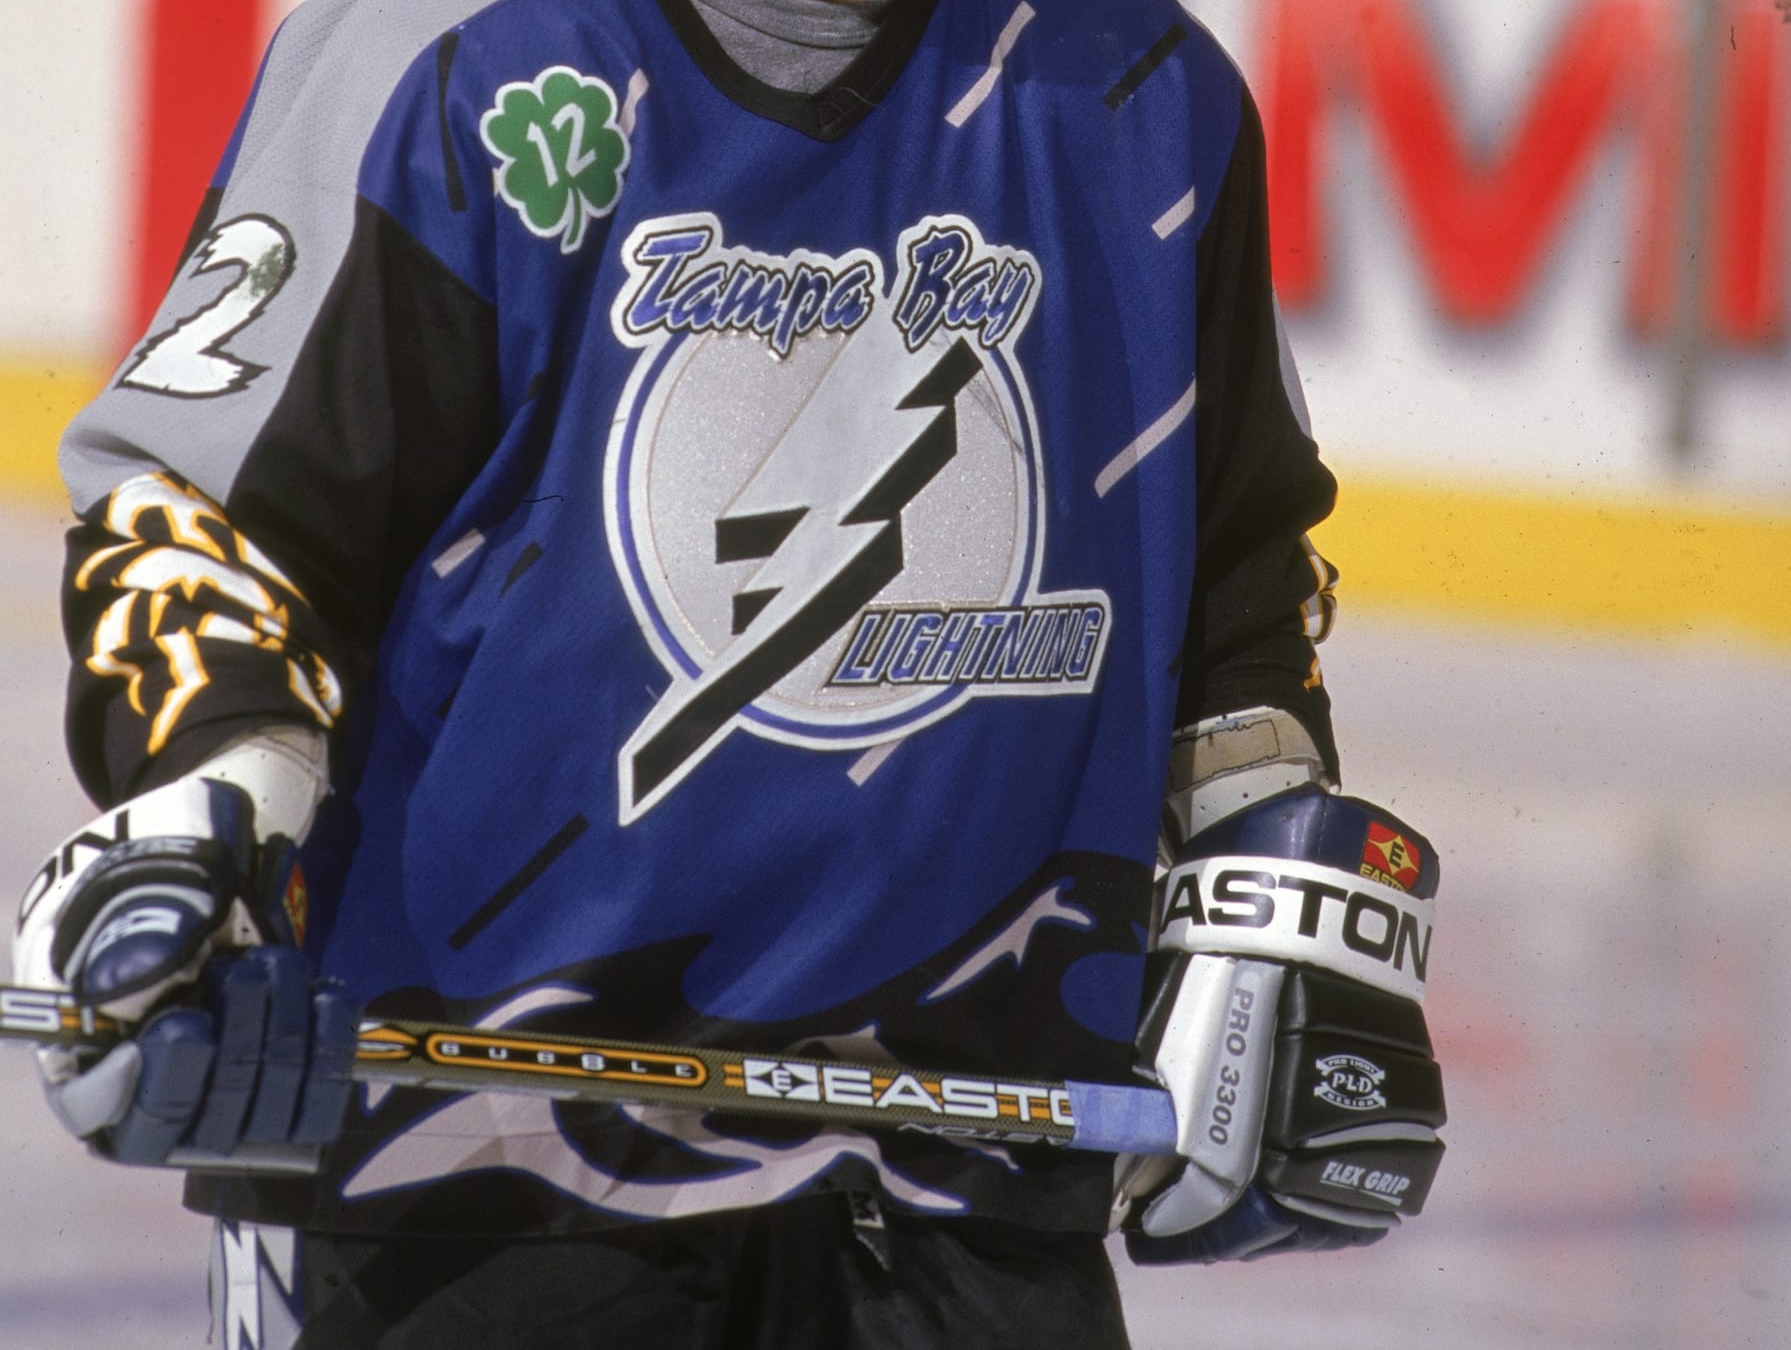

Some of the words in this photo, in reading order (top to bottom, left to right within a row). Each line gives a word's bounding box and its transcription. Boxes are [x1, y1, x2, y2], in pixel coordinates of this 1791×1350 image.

[526, 103, 597, 188] 12
[624, 227, 874, 359] Tampa
[894, 224, 1034, 354] Bay
[827, 605, 1104, 686] LIGHTNING
[1160, 869, 1433, 984] ASTON
[1225, 987, 1255, 1057] PRO
[1208, 1065, 1240, 1146] 3300
[1321, 1161, 1366, 1187] FLEX
[1363, 1171, 1411, 1195] GRIP
